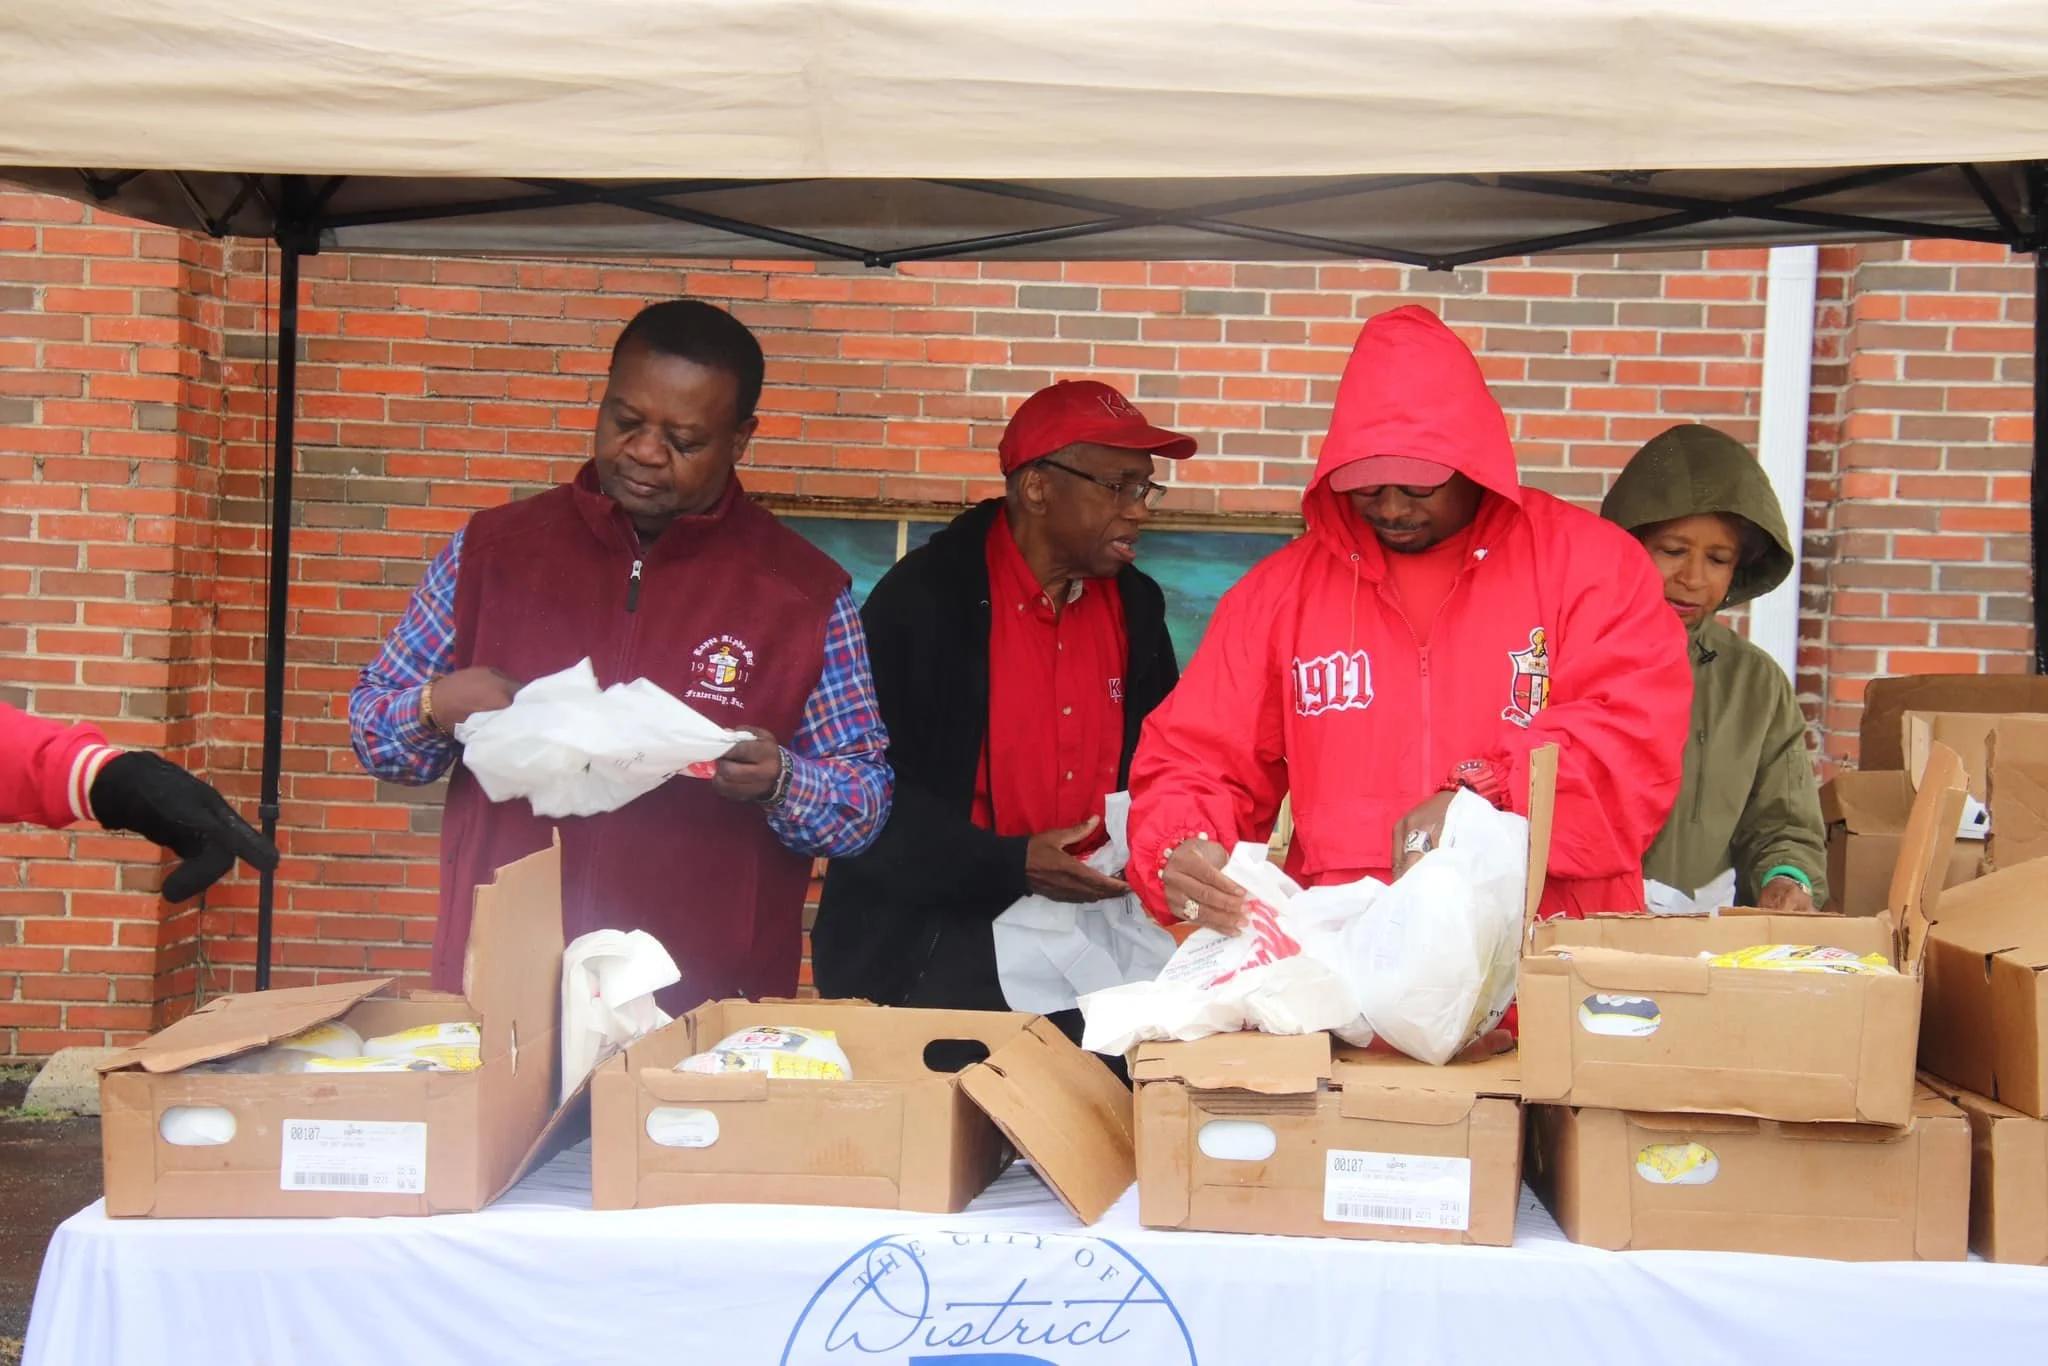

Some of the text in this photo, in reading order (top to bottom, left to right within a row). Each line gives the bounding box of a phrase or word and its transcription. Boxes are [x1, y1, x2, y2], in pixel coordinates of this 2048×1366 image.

[290, 1126, 320, 1141] 00107
[1334, 1157, 1364, 1172] 00107
[853, 1240, 926, 1290] THE
[1073, 1247, 1121, 1283] OF
[825, 1243, 1169, 1353] District
